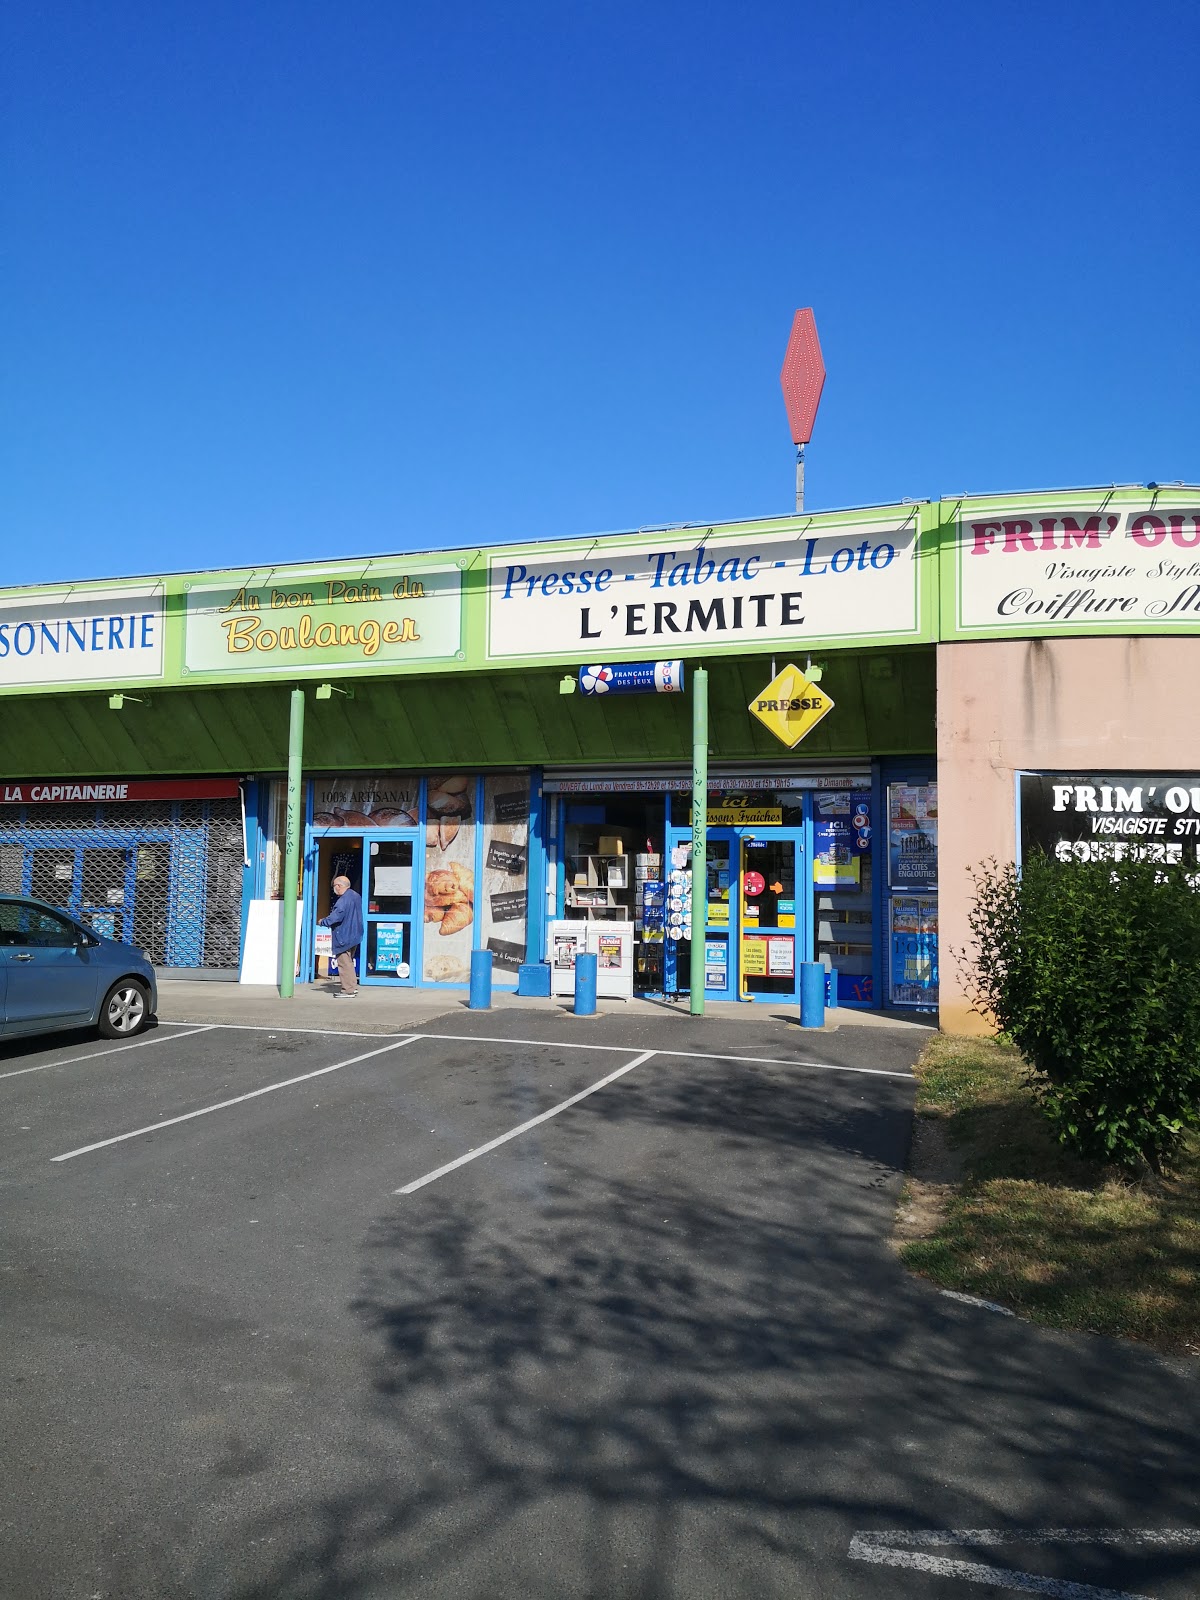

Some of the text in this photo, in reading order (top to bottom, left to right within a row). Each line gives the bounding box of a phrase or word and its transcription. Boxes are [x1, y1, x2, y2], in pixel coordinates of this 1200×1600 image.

[501, 565, 613, 600] Presse
[648, 547, 761, 588] Tabac
[799, 538, 895, 577] Loto
[1045, 562, 1136, 583] Visagiste
[219, 576, 425, 613] Au bon Pain du
[997, 587, 1139, 620] Coiffure
[580, 592, 806, 640] L'ERMITE
[221, 615, 421, 655] Boulanger
[633, 677, 652, 686] JEUX
[661, 661, 673, 691] LOTO
[757, 698, 822, 712] PRESSE
[4, 784, 128, 801] LA CAPITAINERIE
[560, 782, 581, 791] OUVERT
[322, 790, 412, 802] 100% ARTISANAL
[722, 796, 749, 808] ici
[1091, 817, 1168, 834] VISAGISTE
[899, 864, 910, 872] DES
